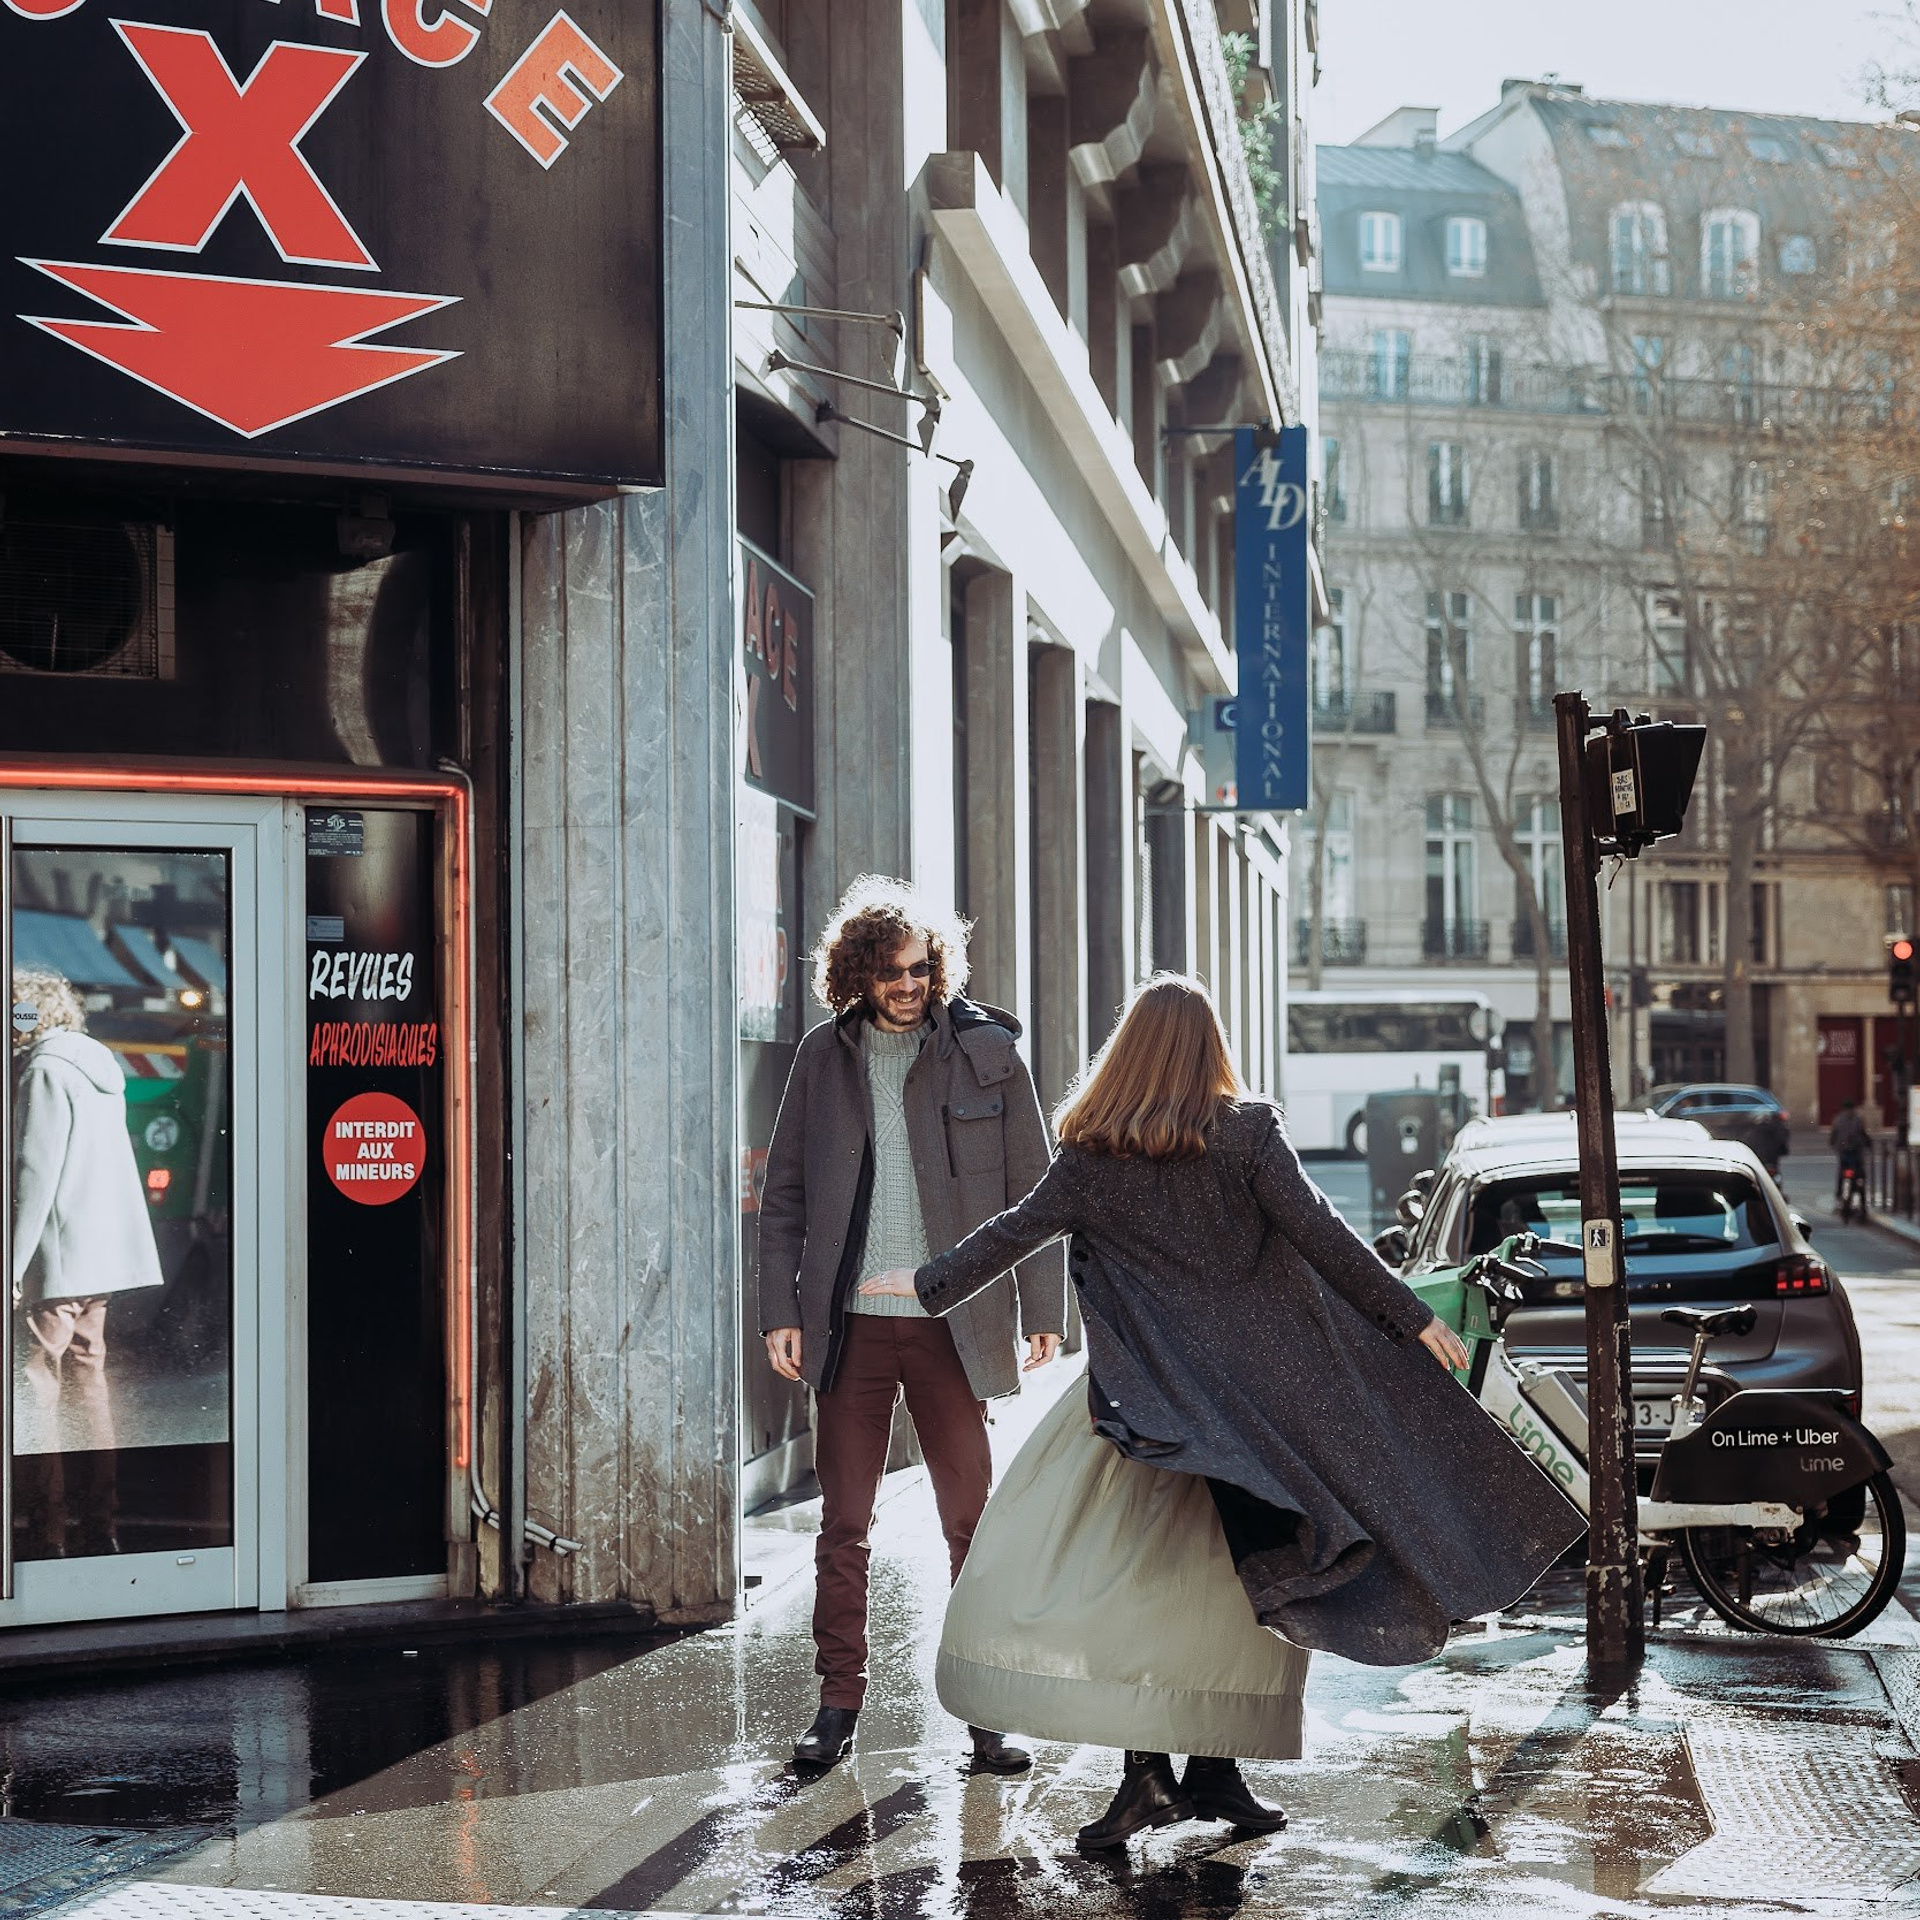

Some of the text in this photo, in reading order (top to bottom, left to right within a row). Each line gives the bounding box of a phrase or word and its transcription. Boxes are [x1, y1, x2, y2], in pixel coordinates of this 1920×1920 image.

[98, 18, 381, 272] X
[1261, 542, 1283, 800] INTERNATIONAL
[309, 949, 415, 1002] REVUES
[309, 1022, 437, 1067] APHRODISIAQUES
[335, 1121, 416, 1139] INTERDIT
[356, 1141, 395, 1159] AUX
[336, 1162, 416, 1180] MINEURS
[1509, 1402, 1574, 1487] Lime
[1711, 1430, 1735, 1447] On
[1738, 1430, 1779, 1446] Lime
[1796, 1428, 1840, 1445] Uber
[1800, 1457, 1846, 1473] Lime
